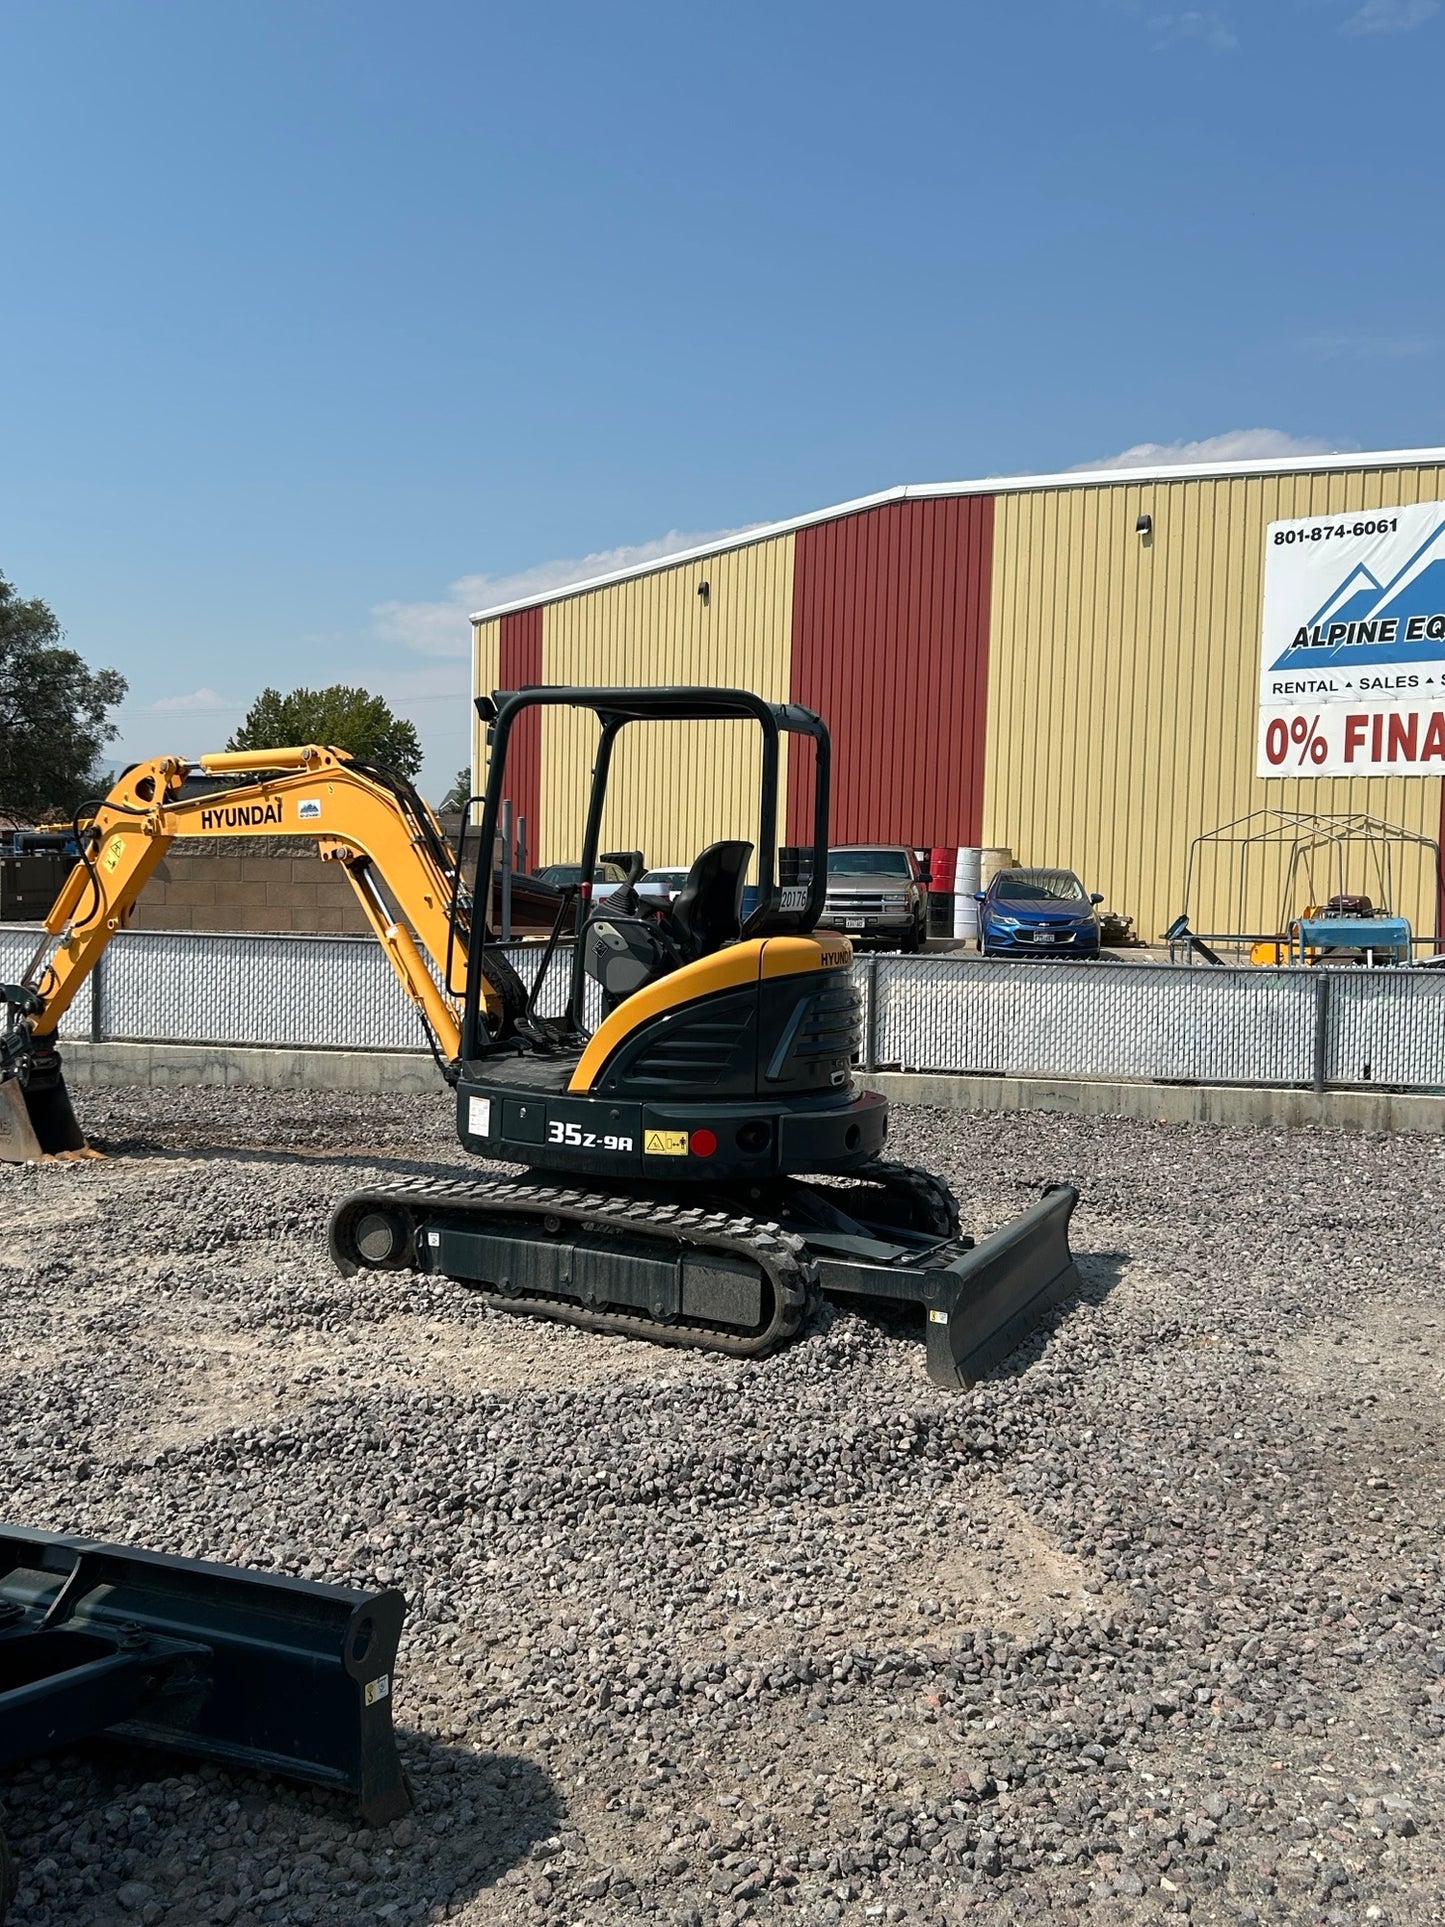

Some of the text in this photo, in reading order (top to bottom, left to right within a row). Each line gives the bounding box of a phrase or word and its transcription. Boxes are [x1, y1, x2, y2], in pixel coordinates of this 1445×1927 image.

[1273, 518, 1398, 545] 801-874-6061
[1290, 618, 1398, 649] ALPINE
[1272, 675, 1419, 694] RENTAL SALES
[1266, 714, 1328, 766] 0%
[201, 803, 282, 829] HYUNDAI
[780, 890, 807, 908] 20176
